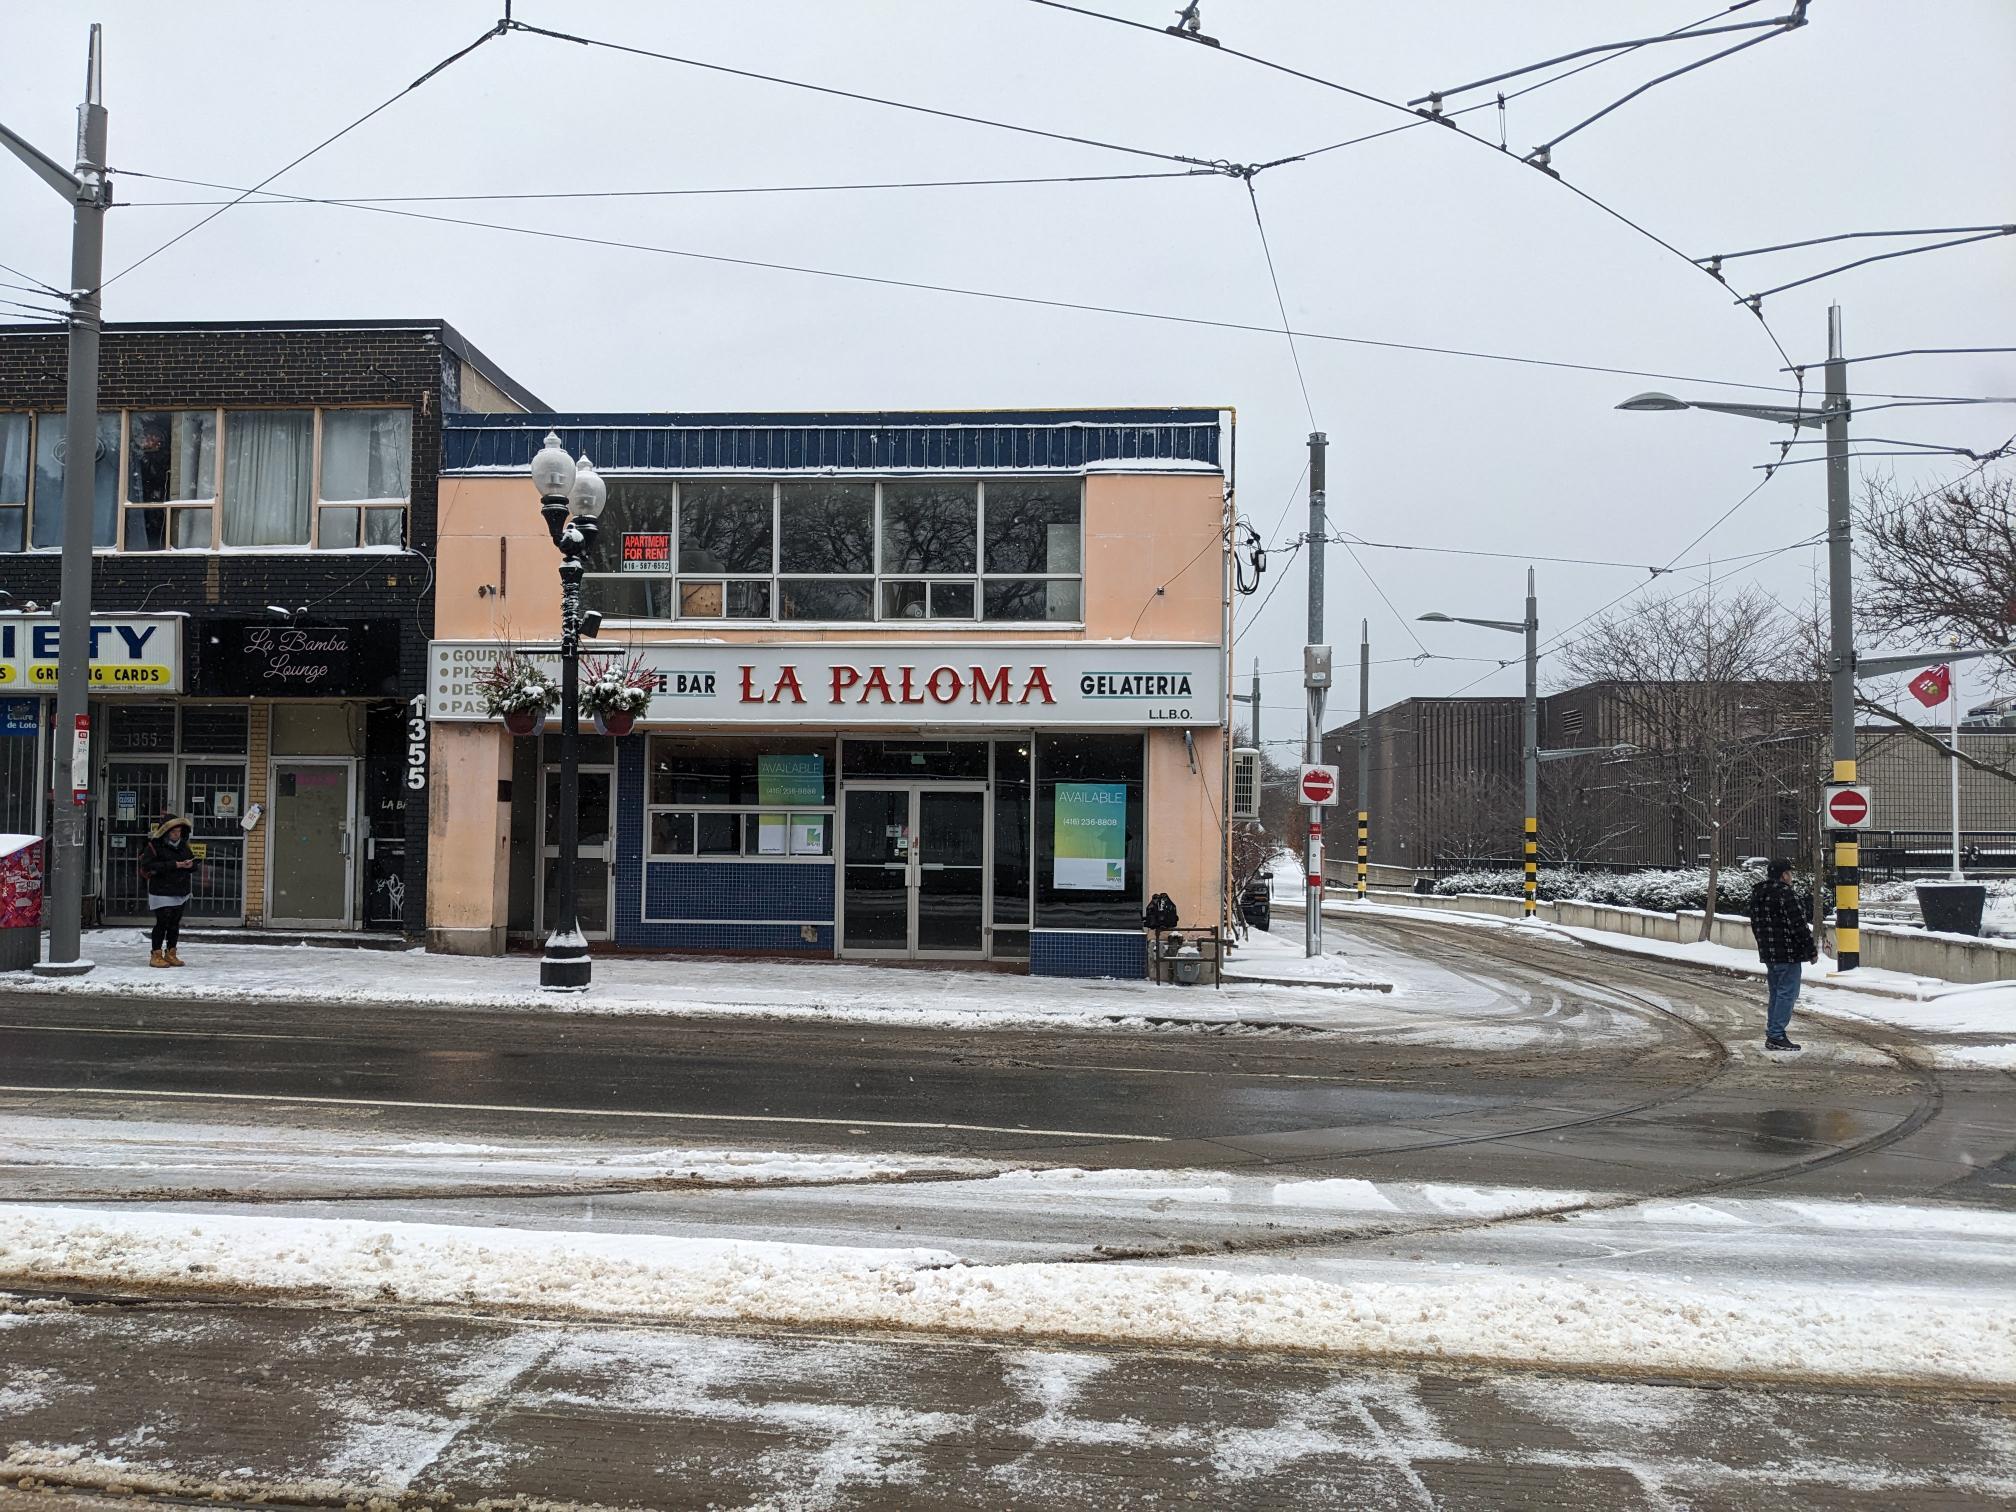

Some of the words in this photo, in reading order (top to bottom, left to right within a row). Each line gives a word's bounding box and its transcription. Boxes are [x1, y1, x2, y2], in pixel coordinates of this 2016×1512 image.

[625, 536, 669, 547] APARTMENT
[625, 548, 642, 559] FOR
[645, 548, 669, 559] RENT
[244, 628, 274, 657] La
[279, 630, 348, 652] Bamba
[453, 650, 526, 662] GOURM
[263, 653, 328, 683] Lounge
[453, 667, 501, 679] PIZZ
[114, 669, 159, 681] CARDS
[677, 674, 715, 693] BAR
[738, 665, 807, 704] LA
[828, 665, 1057, 704] PALOMA
[1080, 675, 1192, 695] GELATERIA
[452, 701, 487, 713] PAS
[1149, 709, 1193, 719] L.L.B.O.
[7, 721, 17, 729] de
[19, 721, 37, 729] Loto
[408, 694, 426, 789] 1355
[762, 763, 820, 774] AVAILABLE
[1059, 791, 1124, 804] AVAILABLE
